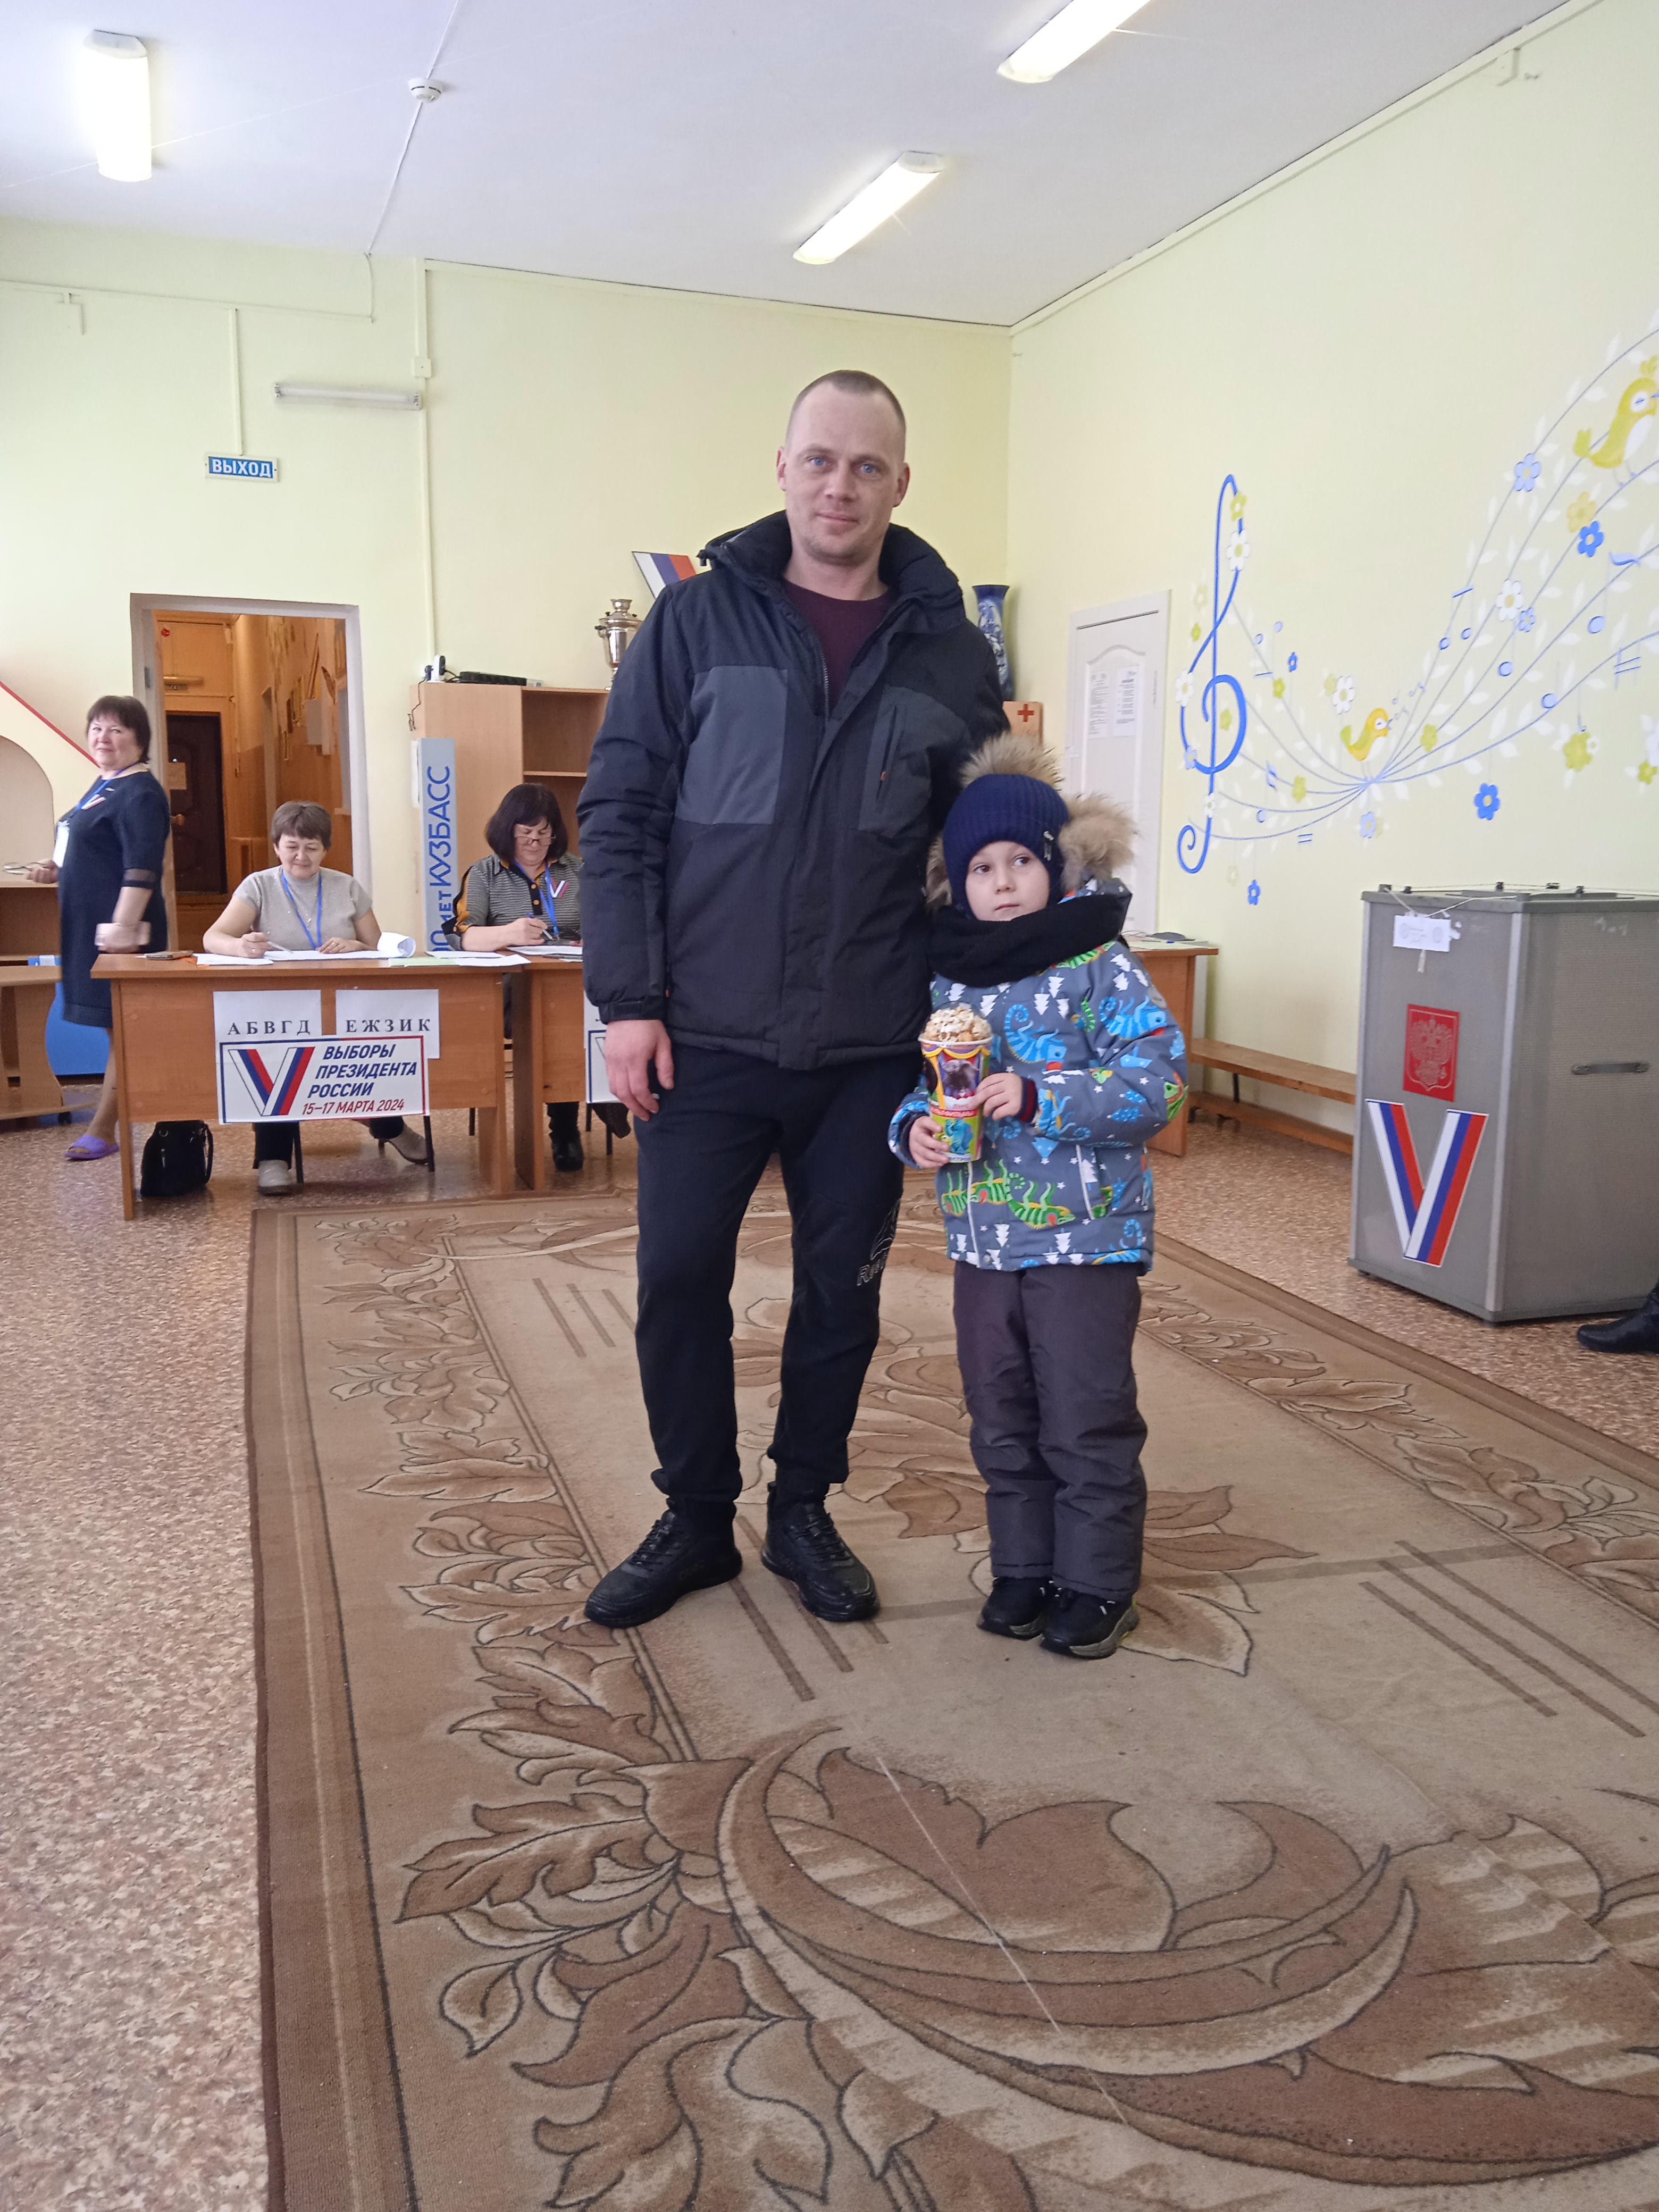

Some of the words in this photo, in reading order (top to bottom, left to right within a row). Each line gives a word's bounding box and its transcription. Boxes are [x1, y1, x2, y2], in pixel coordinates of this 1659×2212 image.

[212, 459, 271, 477] ВЫХОД
[427, 766, 451, 886] КУЗБАСС
[323, 1044, 396, 1060] ВЫБОРЫ
[315, 1062, 417, 1079] ПРЕЗИДЕНТА
[307, 1082, 374, 1098] РОССИИ
[335, 1100, 375, 1113] МАРТА
[376, 1099, 404, 1111] 2024
